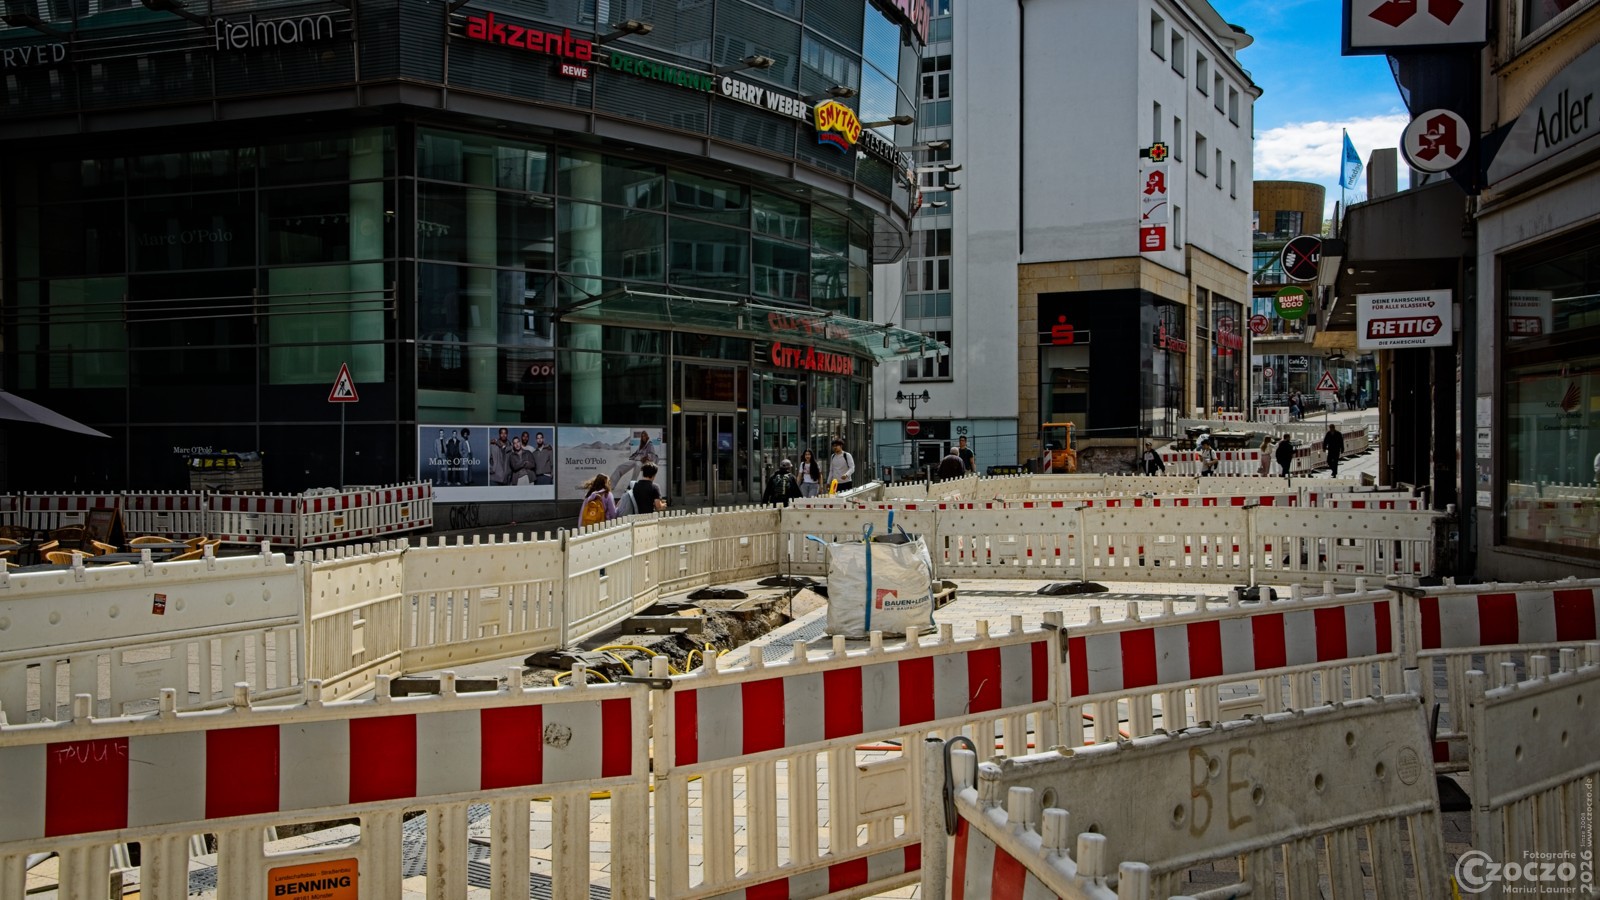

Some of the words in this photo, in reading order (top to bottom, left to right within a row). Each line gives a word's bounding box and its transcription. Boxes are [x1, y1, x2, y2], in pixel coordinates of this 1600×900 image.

[214, 14, 334, 51] fielmann
[467, 12, 592, 61] akzenta
[3, 42, 66, 67] RVED
[562, 65, 587, 78] REWE
[610, 51, 712, 92] DEICHMANN
[721, 76, 765, 107] GERRY
[766, 91, 807, 120] WEBER
[819, 103, 860, 142] SMYTHS
[1533, 88, 1593, 154] Adler
[1279, 294, 1304, 303] BLUME
[1371, 318, 1436, 335] RETTIG
[771, 341, 853, 376] CITY-ARKADEN
[956, 426, 968, 434] 95
[173, 446, 190, 454] Marc
[565, 457, 584, 465] Marc
[585, 457, 607, 465] O'Polo
[429, 457, 452, 466] Marc
[453, 457, 481, 466] O'Polo
[275, 876, 351, 896] BENNING
